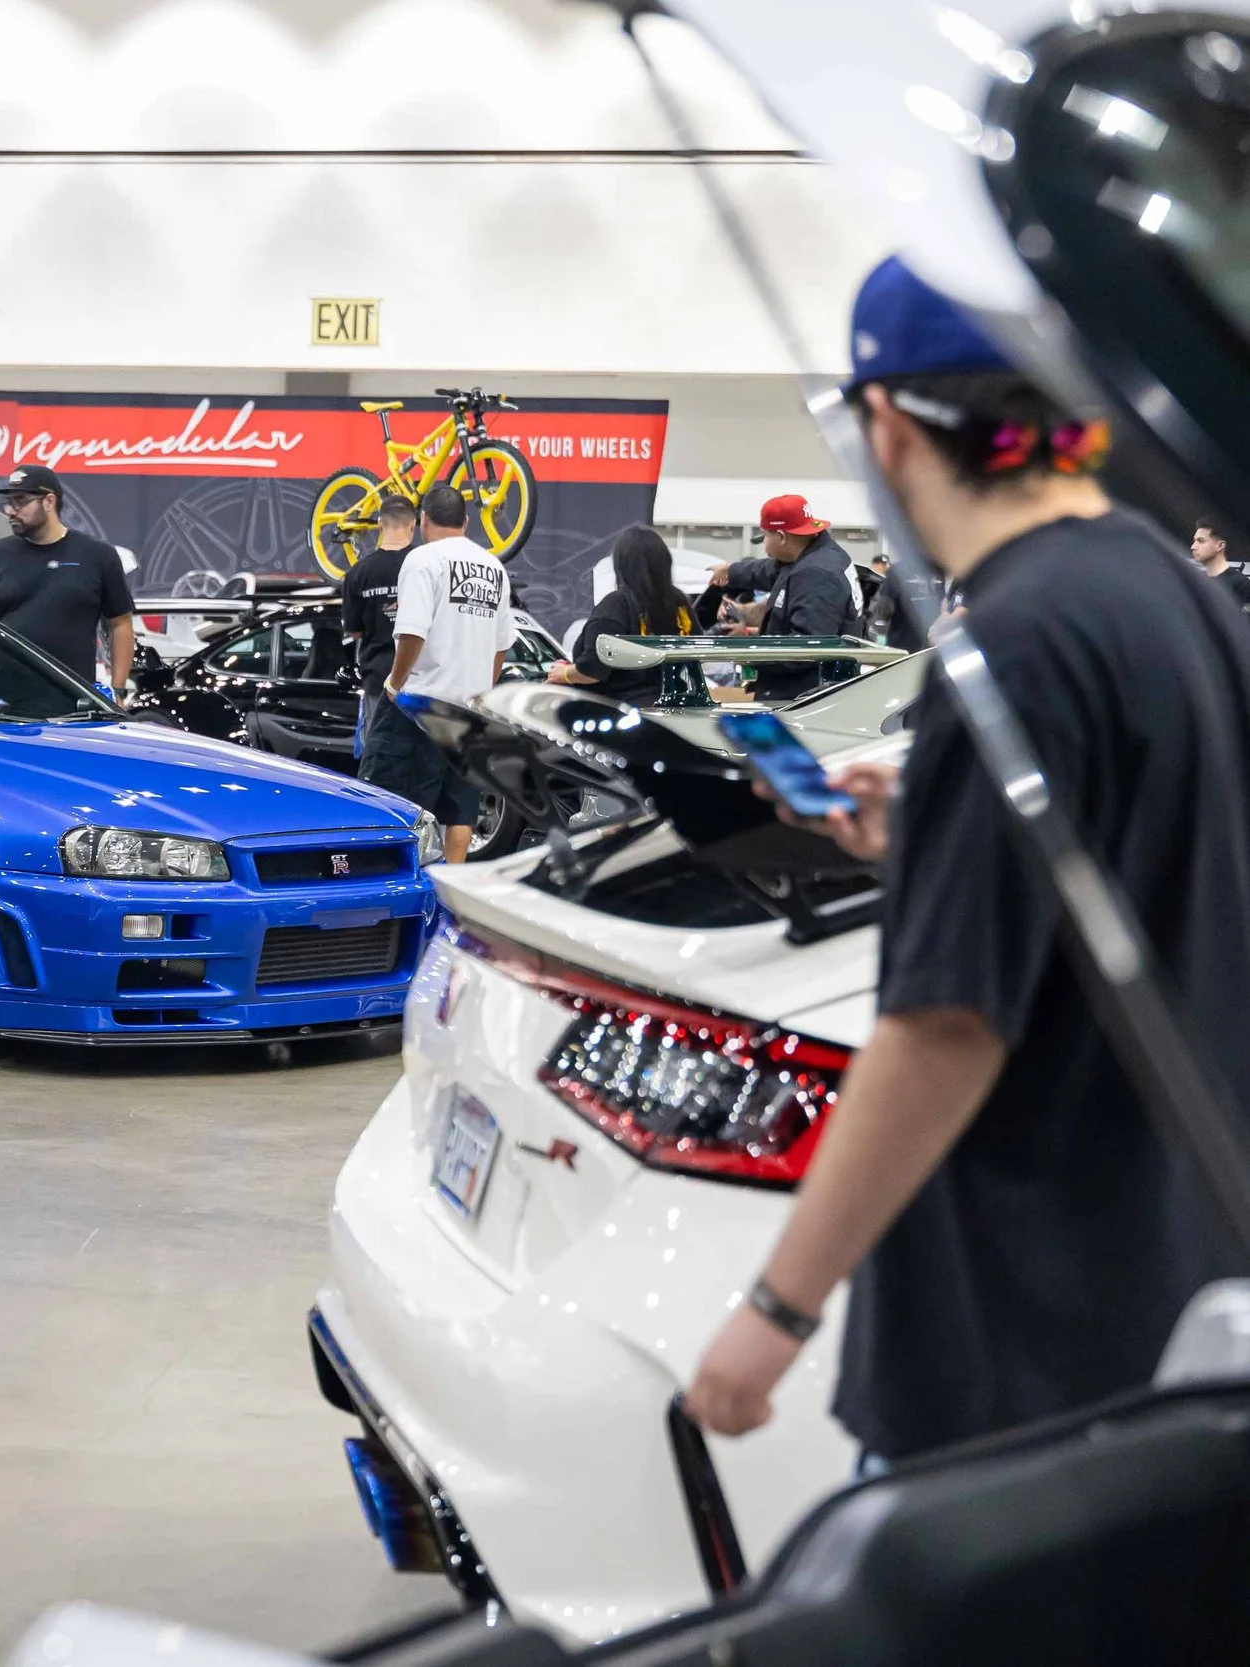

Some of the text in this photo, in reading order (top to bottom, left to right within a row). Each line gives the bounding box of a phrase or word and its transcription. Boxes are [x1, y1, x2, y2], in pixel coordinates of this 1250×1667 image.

[317, 303, 375, 341] EXIT
[528, 435, 574, 458] YOUR
[581, 436, 652, 460] WHEELS
[448, 560, 503, 604] KUSTOM
